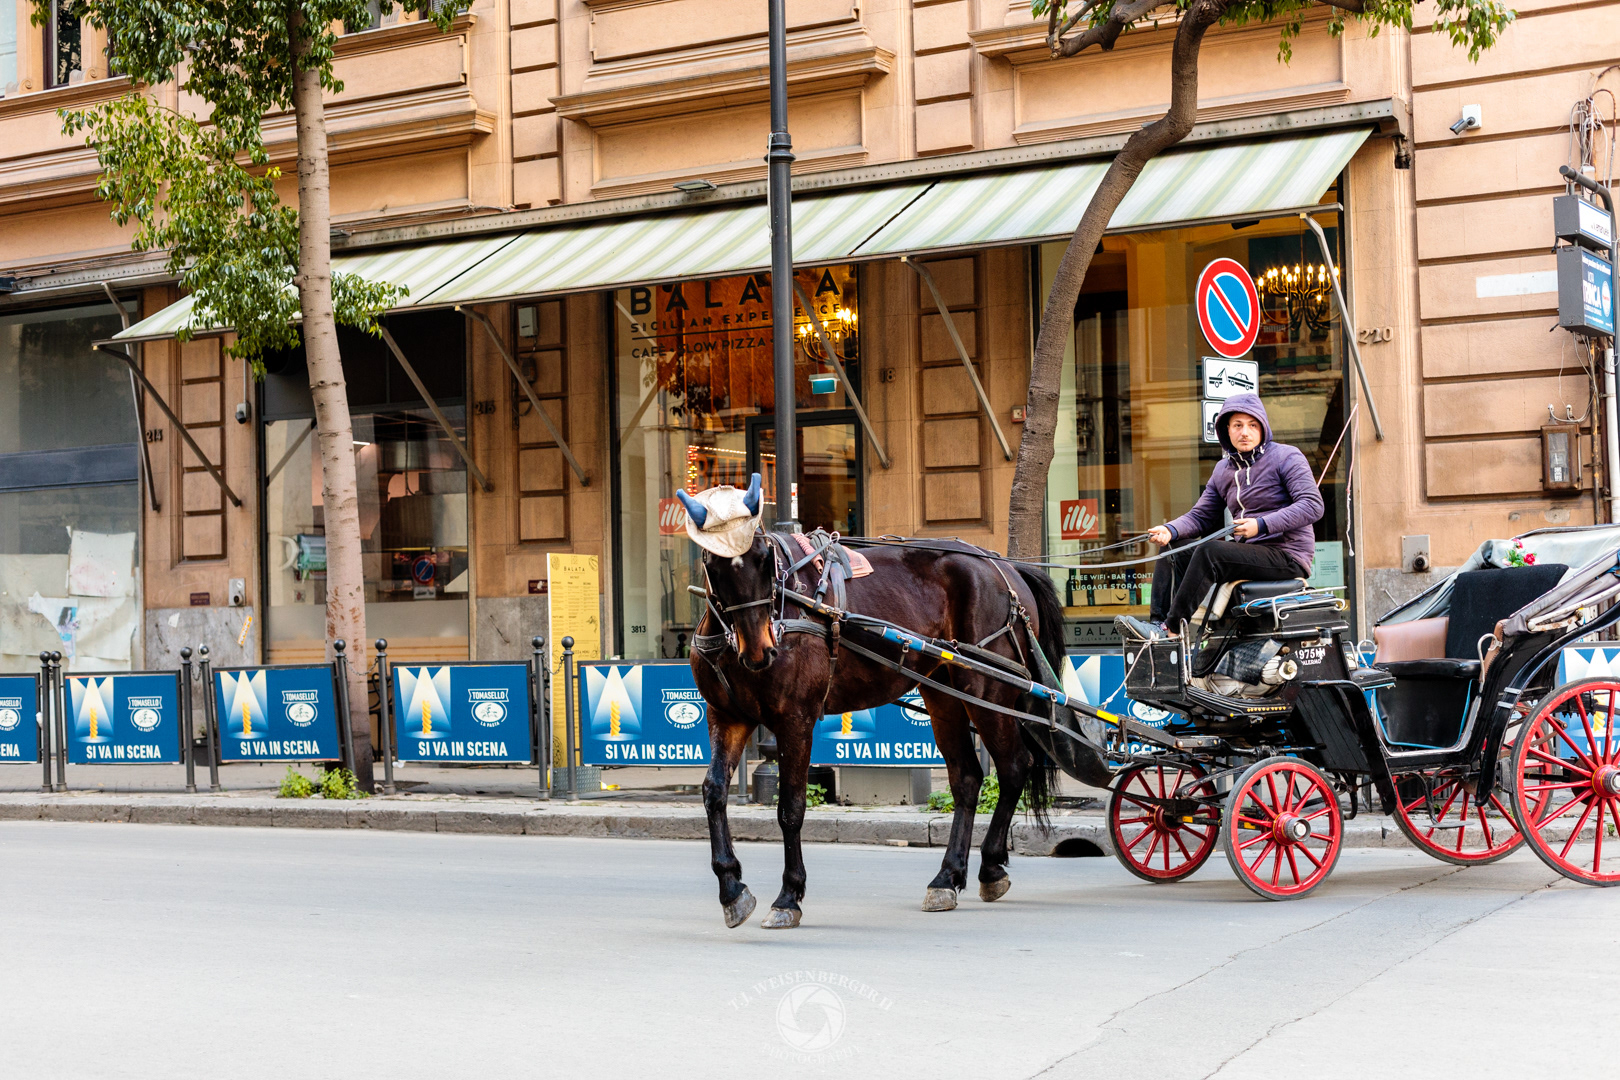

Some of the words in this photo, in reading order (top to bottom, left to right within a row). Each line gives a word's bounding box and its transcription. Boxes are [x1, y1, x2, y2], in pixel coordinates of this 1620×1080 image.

[630, 267, 841, 316] BALAA
[630, 316, 712, 333] SICILIAN
[1358, 327, 1394, 345] 220
[631, 344, 667, 358] CAFÈ
[678, 340, 717, 355] SLOW
[721, 337, 766, 350] PIZZA
[1062, 504, 1096, 537] illy
[631, 625, 647, 634] 3813
[1074, 627, 1119, 636] BALA
[1294, 649, 1315, 660] 1975
[471, 691, 505, 700] TOMASELLO
[665, 691, 702, 700] TOMASELLO
[0, 743, 20, 757] ENA
[86, 745, 96, 759] SI
[98, 745, 112, 759] VA
[113, 745, 125, 759] IN
[126, 744, 162, 759] SCENA
[240, 741, 251, 756] SI
[252, 741, 268, 755] VA
[269, 741, 281, 755] IN
[283, 740, 320, 755] SCENA
[418, 741, 431, 757] SI
[432, 741, 449, 757] VA
[451, 741, 465, 757] IN
[466, 741, 508, 757] SCENA
[605, 744, 618, 760] SI
[620, 744, 639, 760] VA
[641, 744, 655, 760] IN
[658, 744, 704, 760] SCENA
[835, 742, 850, 759] SI
[852, 742, 872, 759] VA
[875, 742, 890, 759] IN
[894, 742, 944, 759] SCENA
